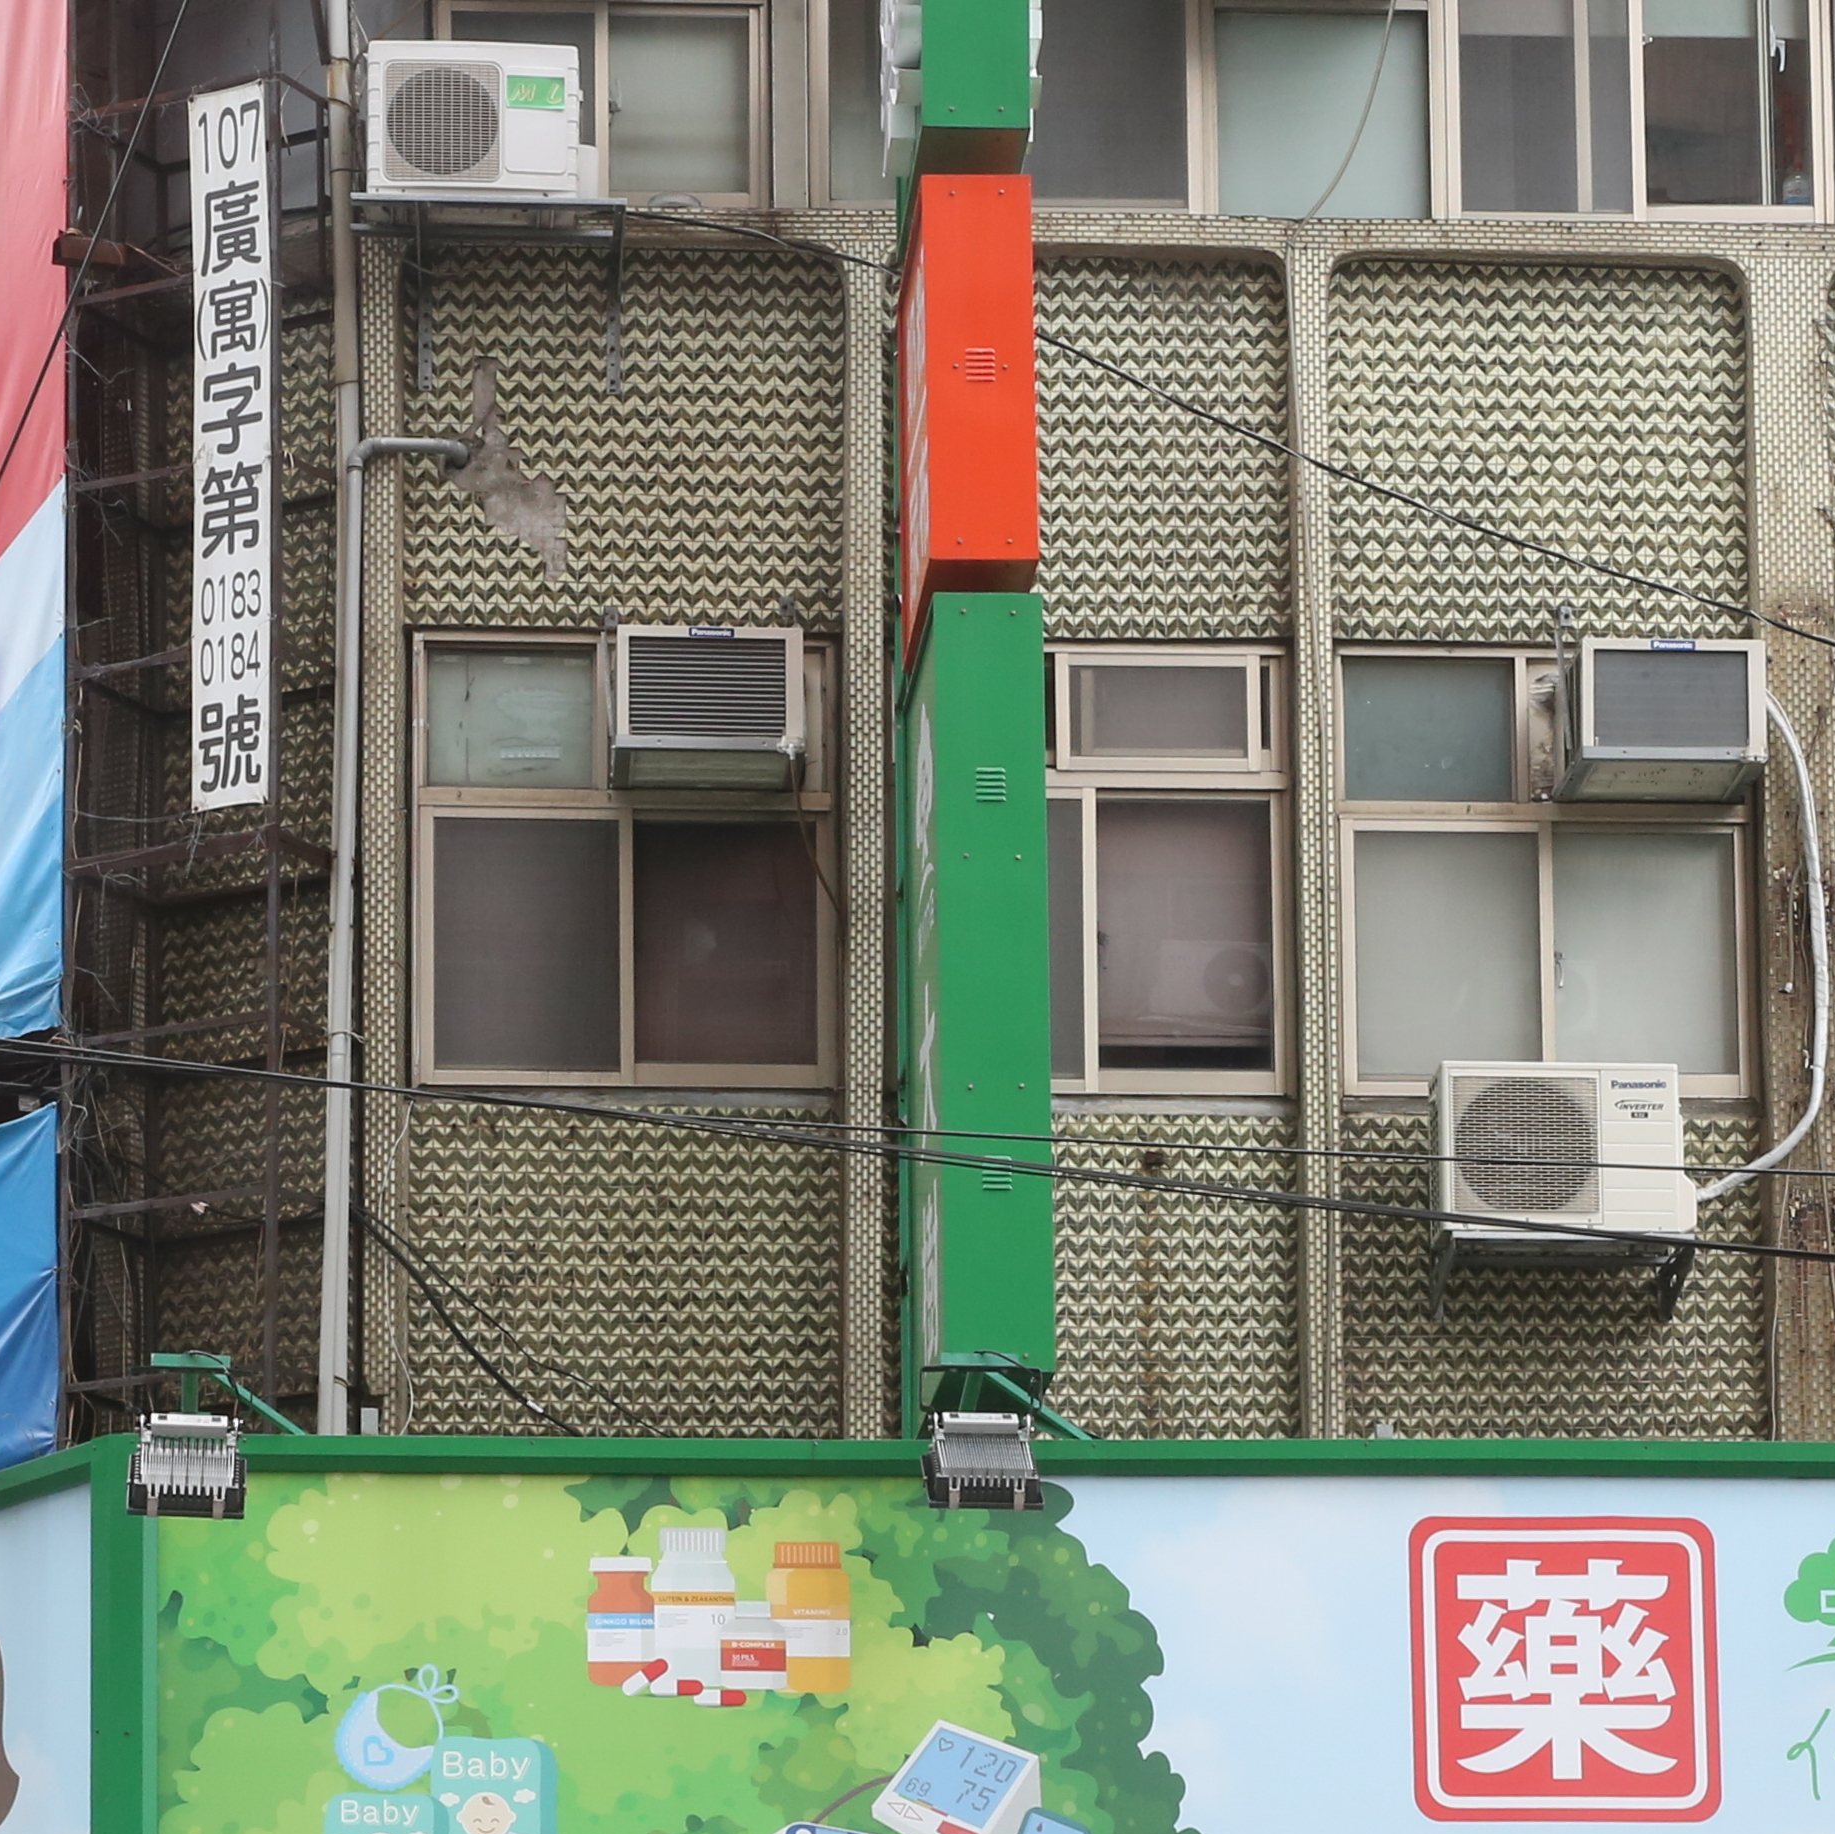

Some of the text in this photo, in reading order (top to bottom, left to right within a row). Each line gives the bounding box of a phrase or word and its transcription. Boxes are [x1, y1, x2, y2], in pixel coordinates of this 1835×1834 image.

[1652, 640, 1694, 650] Panasonic
[1611, 1079, 1667, 1089] Panasonic
[1618, 1102, 1665, 1112] INVERTER
[711, 1613, 725, 1625] 10
[731, 1641, 776, 1649] B-COMPLEX
[1455, 1554, 1679, 1782] 藥
[441, 1748, 533, 1786] Baby
[959, 1745, 1018, 1785] 120
[905, 1777, 933, 1797] 69
[955, 1779, 997, 1813] 75
[338, 1797, 421, 1830] Baby
